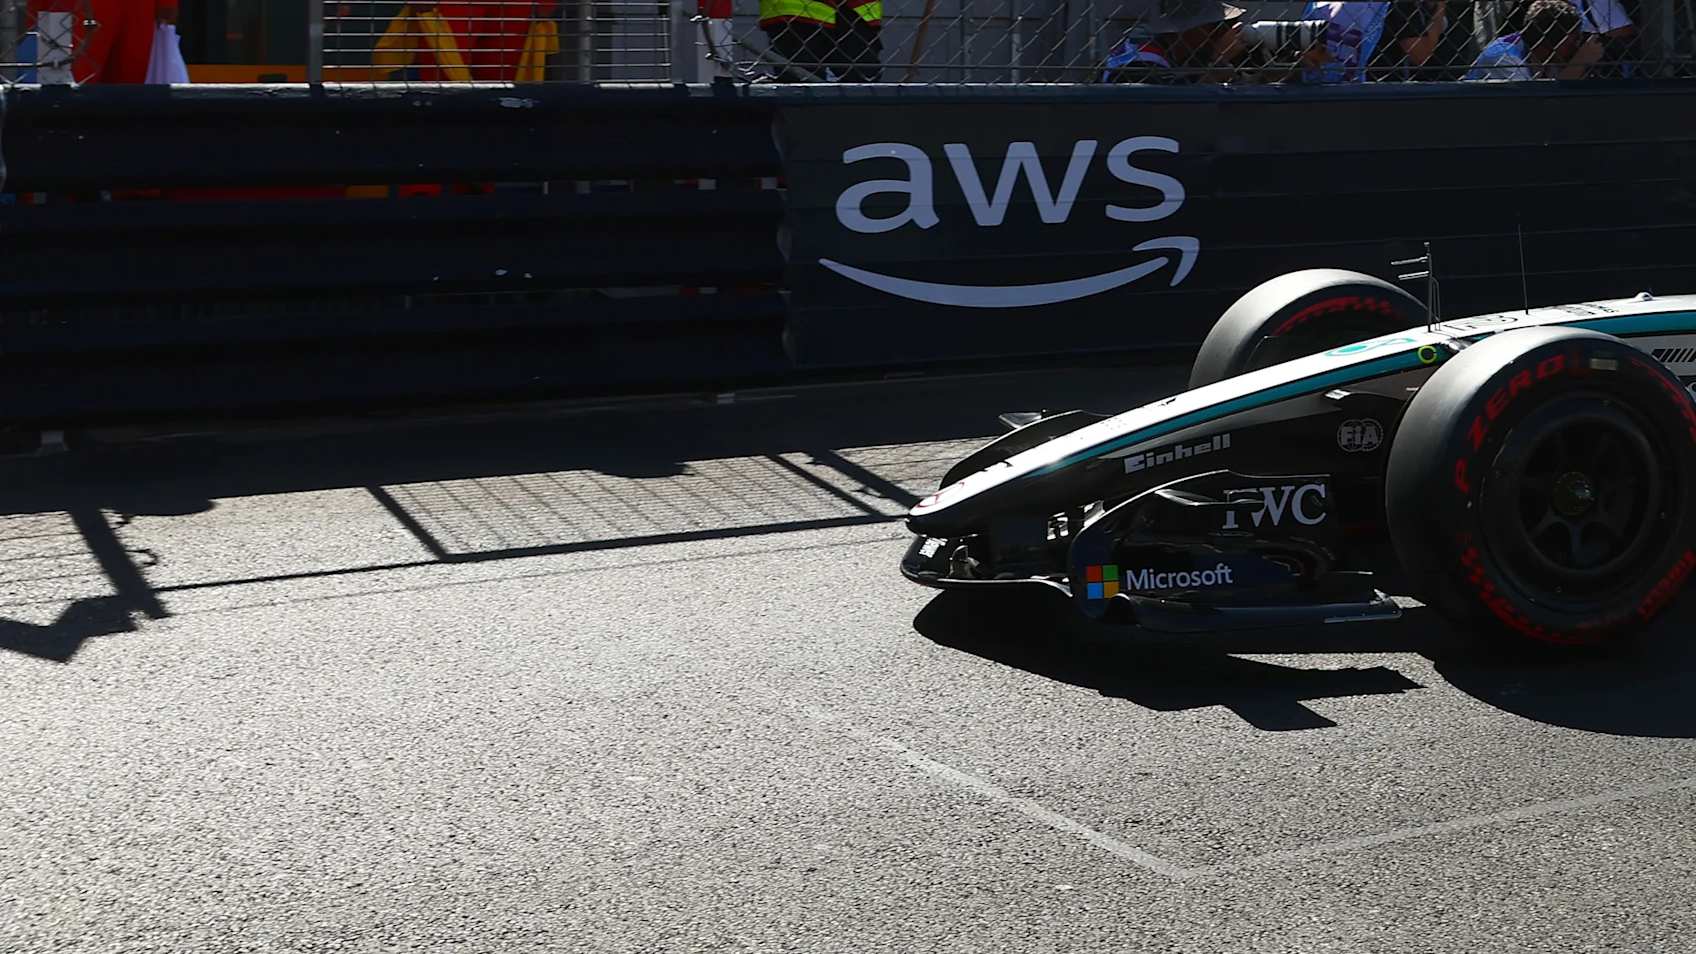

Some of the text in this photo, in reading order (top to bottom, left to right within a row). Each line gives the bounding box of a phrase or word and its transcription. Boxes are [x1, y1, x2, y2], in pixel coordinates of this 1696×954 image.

[835, 135, 1186, 234] aws
[1466, 352, 1564, 453] ZERO
[1124, 433, 1231, 474] Einhell
[1126, 562, 1234, 591] Microsoft
